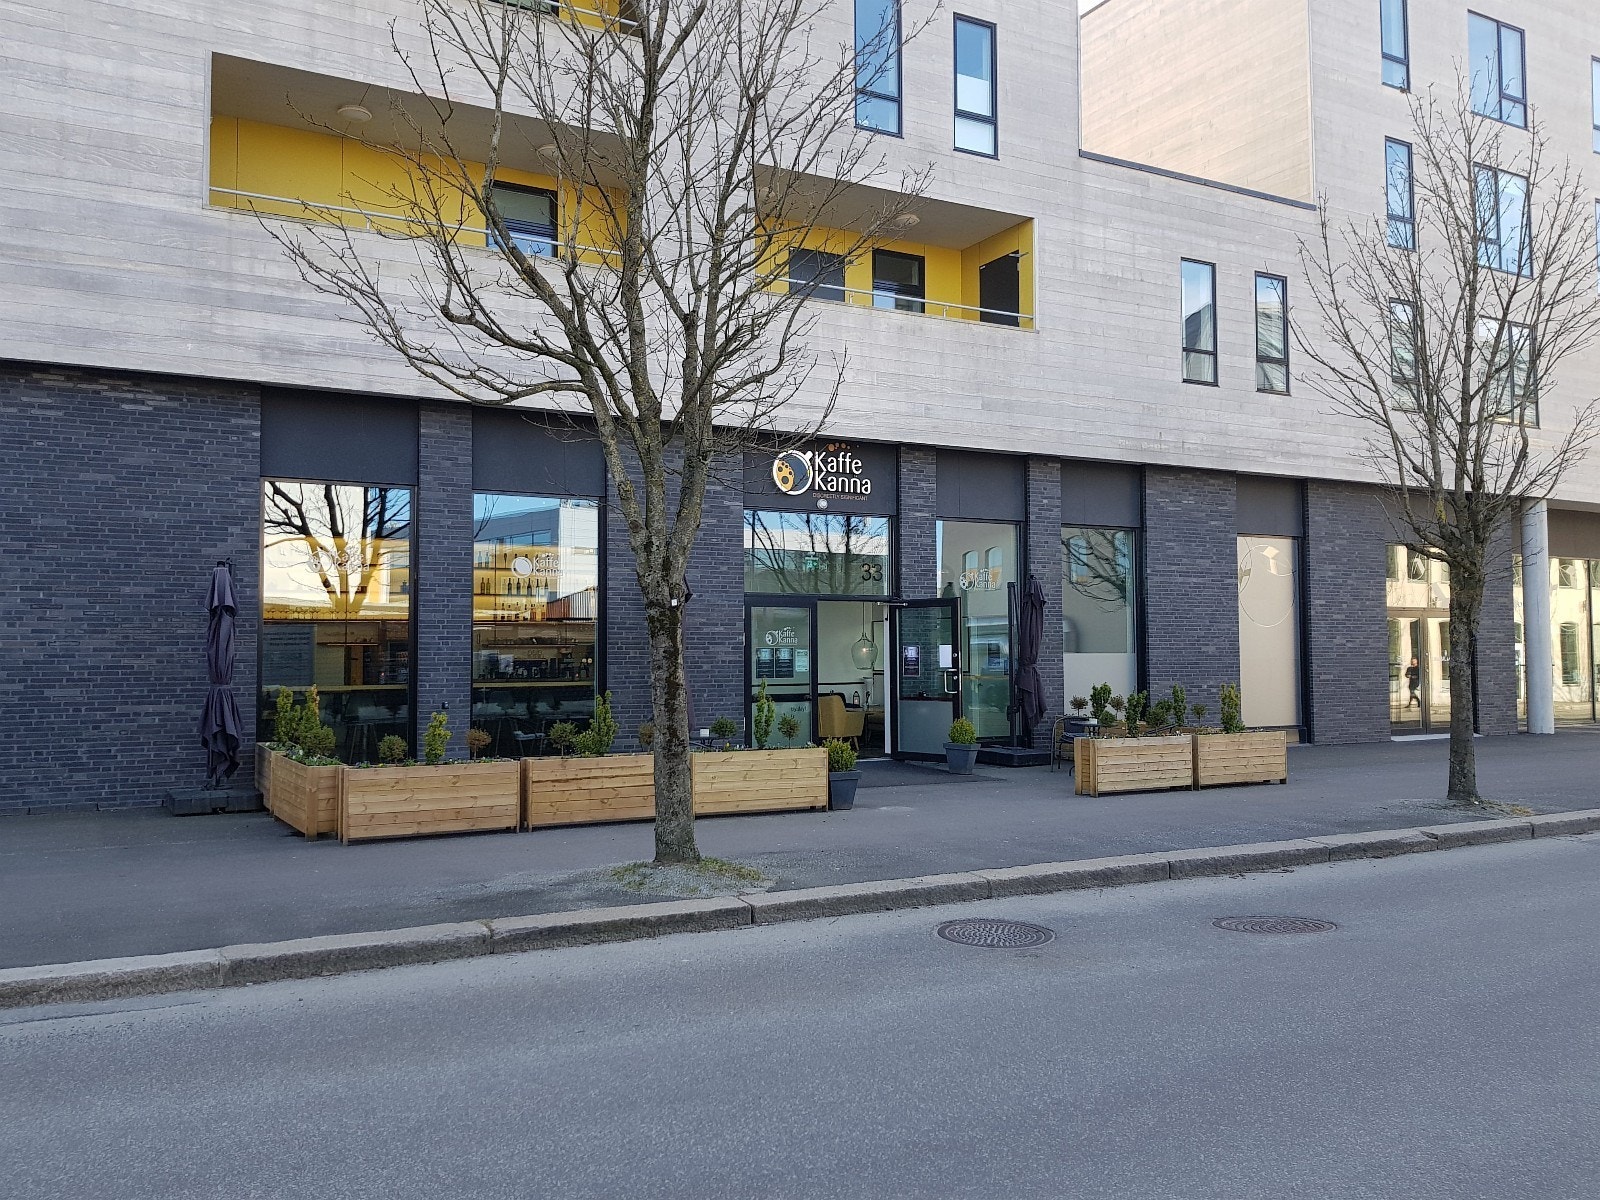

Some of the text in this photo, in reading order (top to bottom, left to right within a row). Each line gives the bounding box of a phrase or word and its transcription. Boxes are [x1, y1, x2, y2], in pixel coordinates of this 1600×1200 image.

[815, 451, 862, 475] Kaffe
[815, 471, 871, 494] Kanna
[533, 556, 559, 568] Kaffe
[861, 563, 883, 581] 33
[975, 580, 996, 589] Kanna
[778, 636, 798, 644] Kanna
